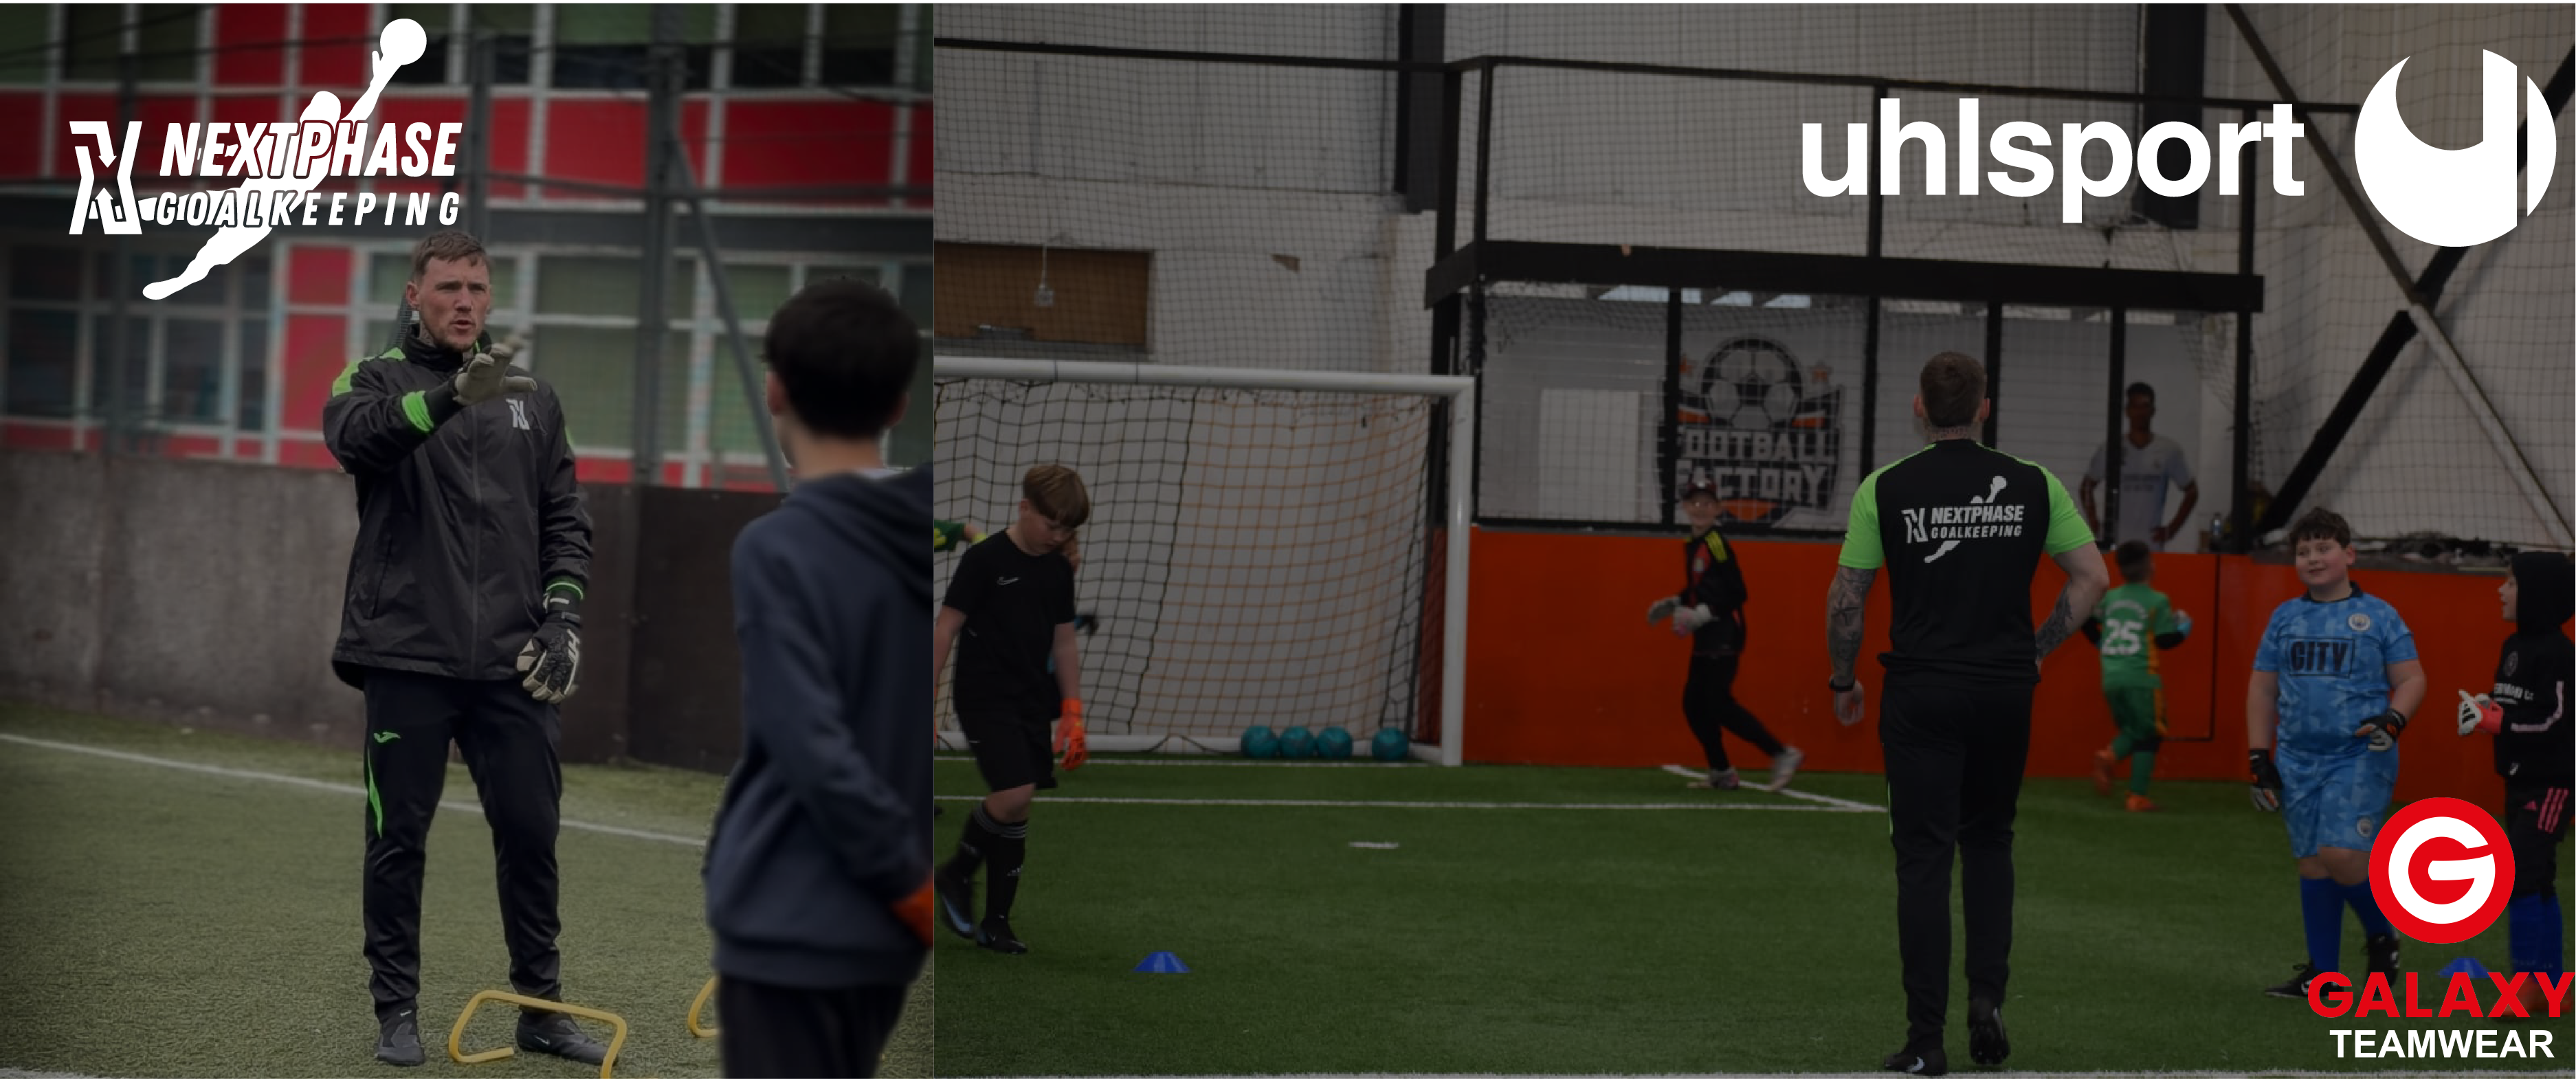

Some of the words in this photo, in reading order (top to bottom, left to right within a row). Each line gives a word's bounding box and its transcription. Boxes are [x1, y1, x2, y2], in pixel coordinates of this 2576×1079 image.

[1931, 505, 2025, 524] NEXTPHASE
[1931, 525, 2022, 539] GOALKEEPING
[2102, 619, 2143, 656] 25
[2290, 641, 2349, 673] CITY
